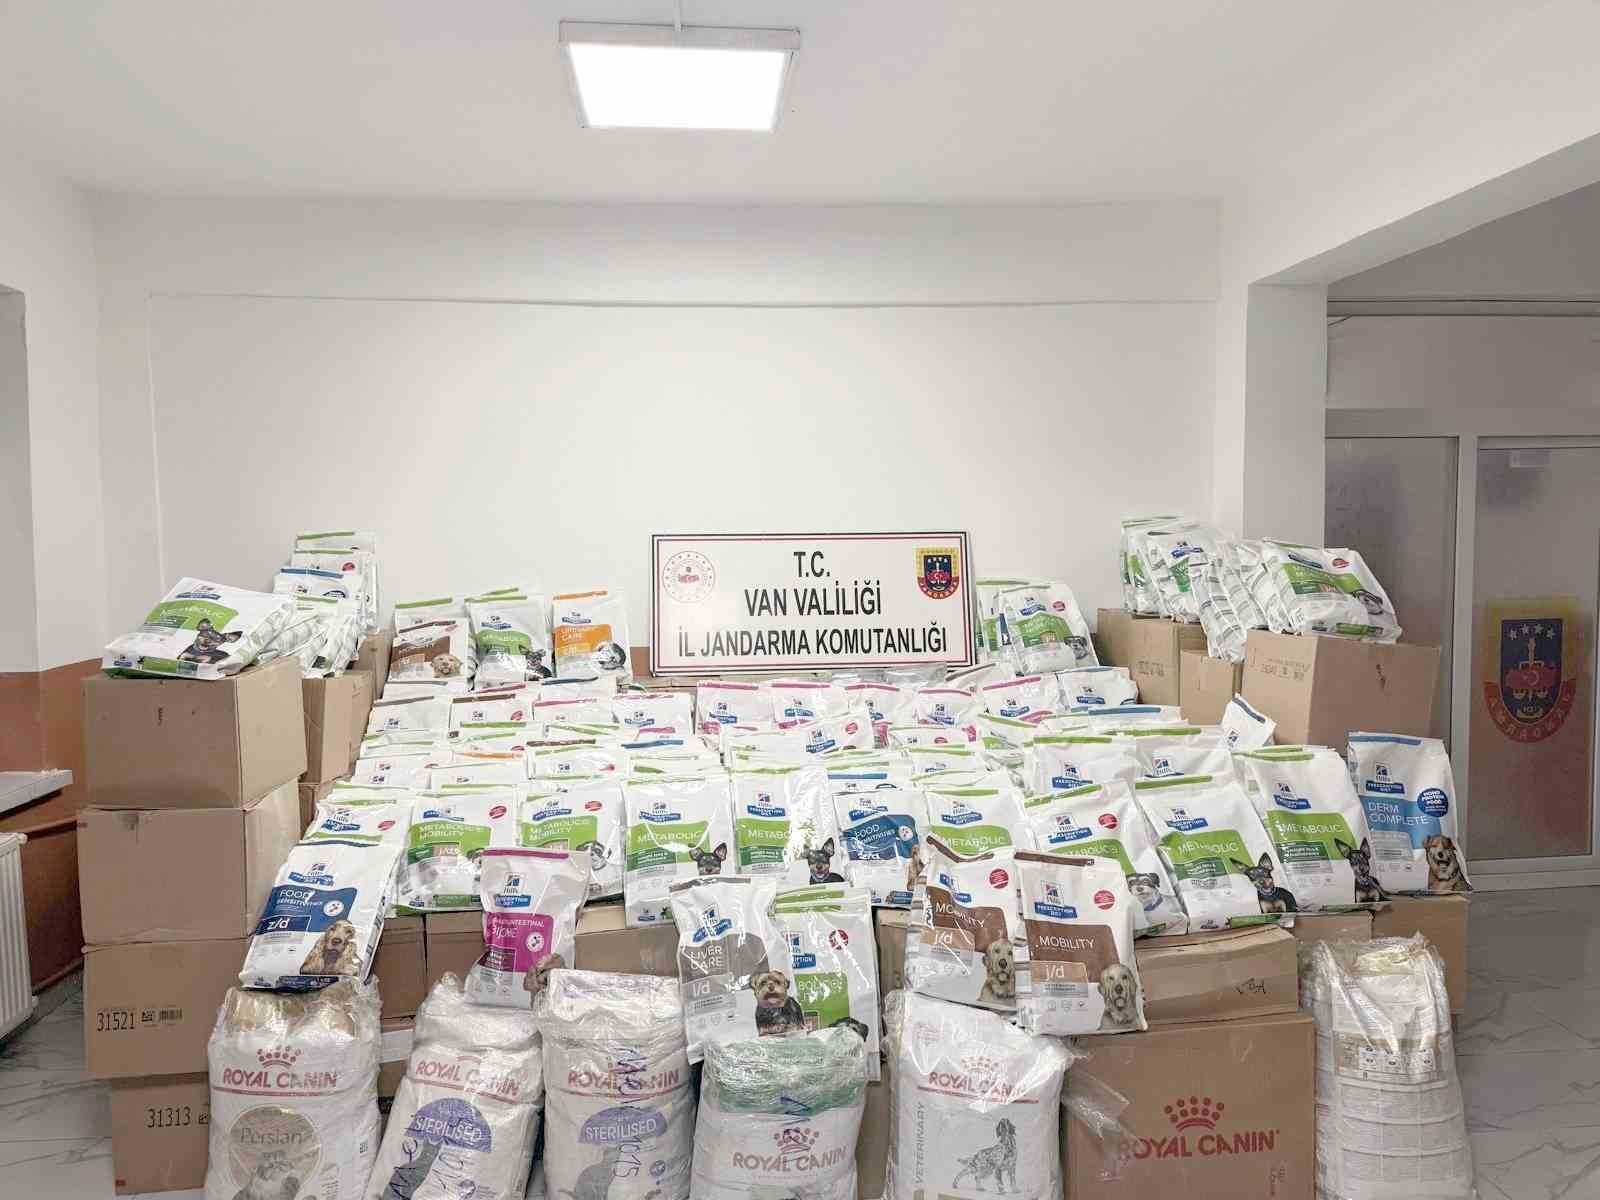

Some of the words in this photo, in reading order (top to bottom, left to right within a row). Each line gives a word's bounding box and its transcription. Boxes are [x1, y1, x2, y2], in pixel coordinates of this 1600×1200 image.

[793, 551, 831, 578] T.C.
[744, 588, 787, 616] VAN
[793, 580, 881, 616] VALİLİĞİ
[678, 626, 696, 657] İL
[700, 629, 811, 657] JANDARMA
[816, 621, 947, 654] KOMUTANLIĞI
[1368, 802, 1399, 814] DERM
[1368, 814, 1429, 826] COMPLETE
[855, 824, 880, 838] FOOD
[280, 888, 313, 901] FOOD
[268, 917, 291, 930] z/d
[690, 945, 723, 960] LIVER
[1039, 936, 1095, 949] MOBILITY
[690, 957, 723, 971] CARE
[1045, 964, 1065, 981] j/d
[96, 1011, 135, 1031] 31521
[223, 1067, 272, 1089] ROYAL
[276, 1071, 338, 1089] CANIN
[416, 1060, 461, 1081] ROYAL
[568, 1070, 618, 1090] ROYAL
[928, 1071, 975, 1092] ROYAL
[146, 1106, 191, 1128] 31313
[240, 1127, 302, 1145] Persian
[414, 1115, 483, 1143] STERILISED
[585, 1118, 658, 1141] STERILISED
[1198, 1130, 1275, 1156] CANIN
[732, 1151, 791, 1172] ROYAL
[796, 1147, 847, 1172] CANIN
